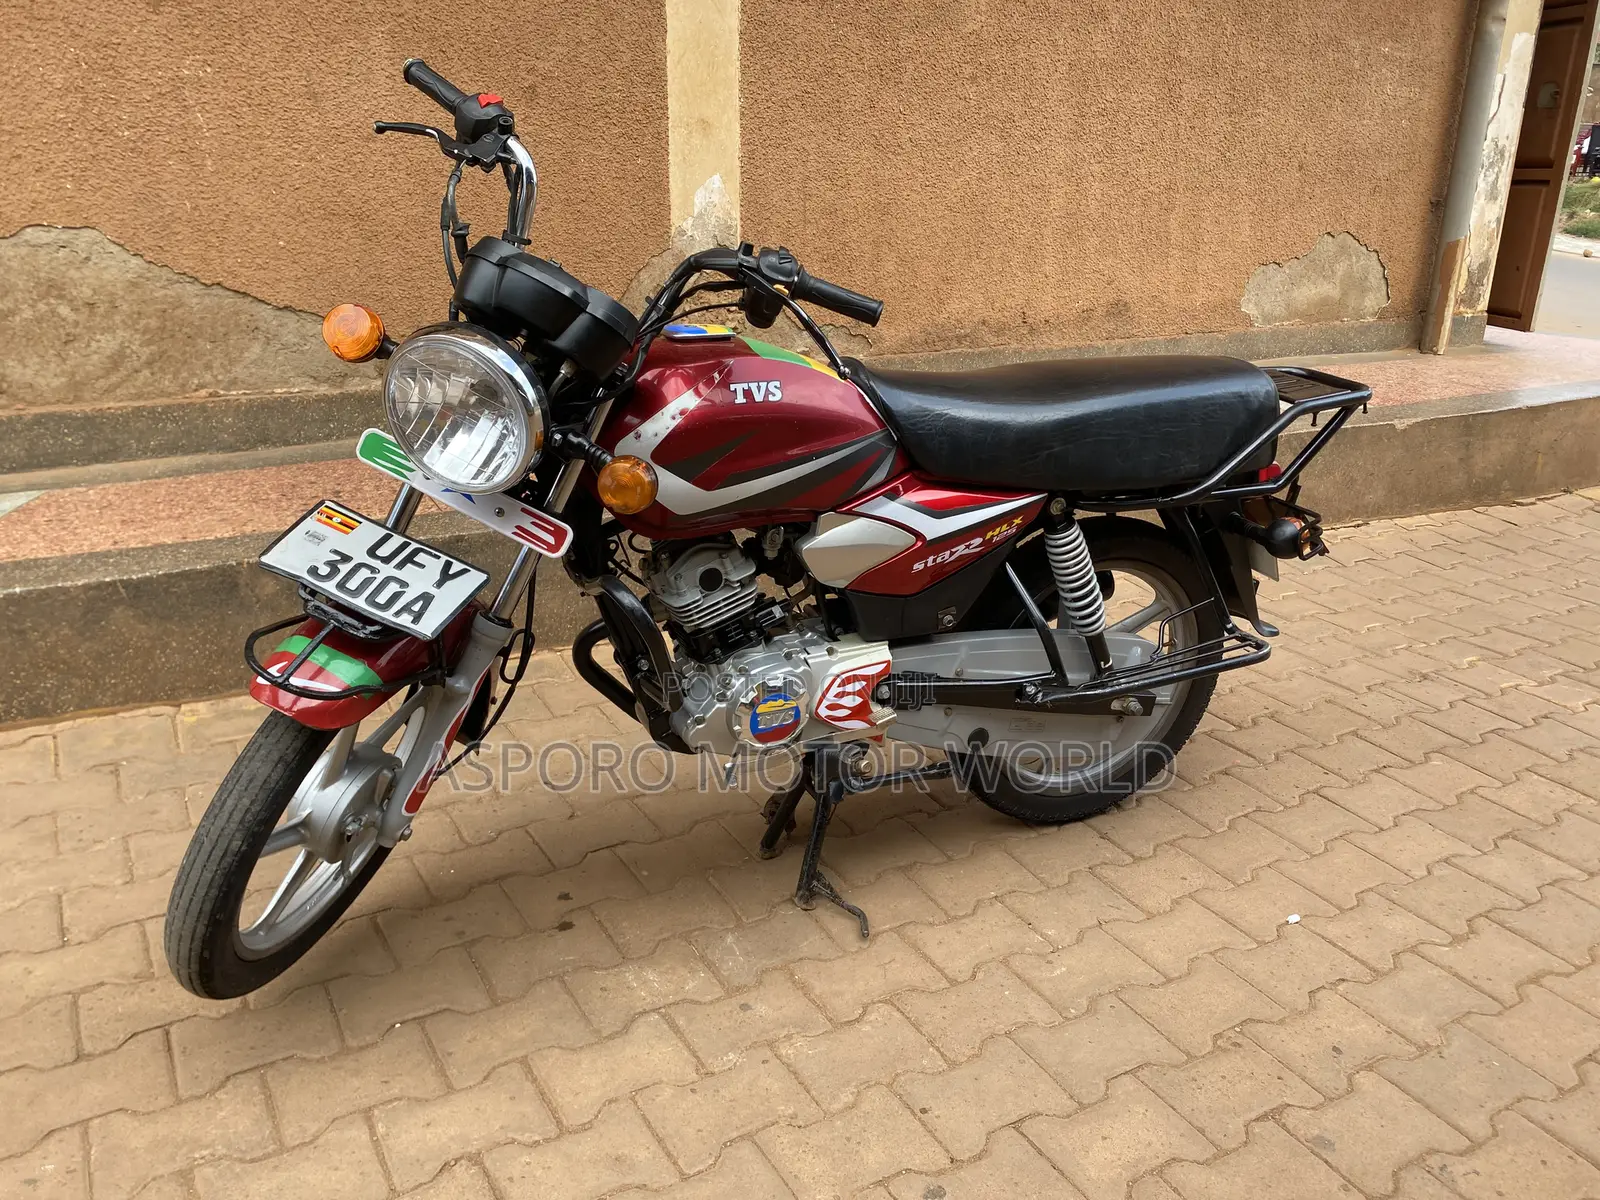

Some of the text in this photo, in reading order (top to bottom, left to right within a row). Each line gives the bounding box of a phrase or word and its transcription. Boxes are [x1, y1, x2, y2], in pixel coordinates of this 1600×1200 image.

[729, 380, 783, 404] TVS
[984, 515, 1024, 540] HLX
[992, 526, 1018, 543] 125
[366, 532, 471, 590] UFY
[307, 548, 435, 625] 300A
